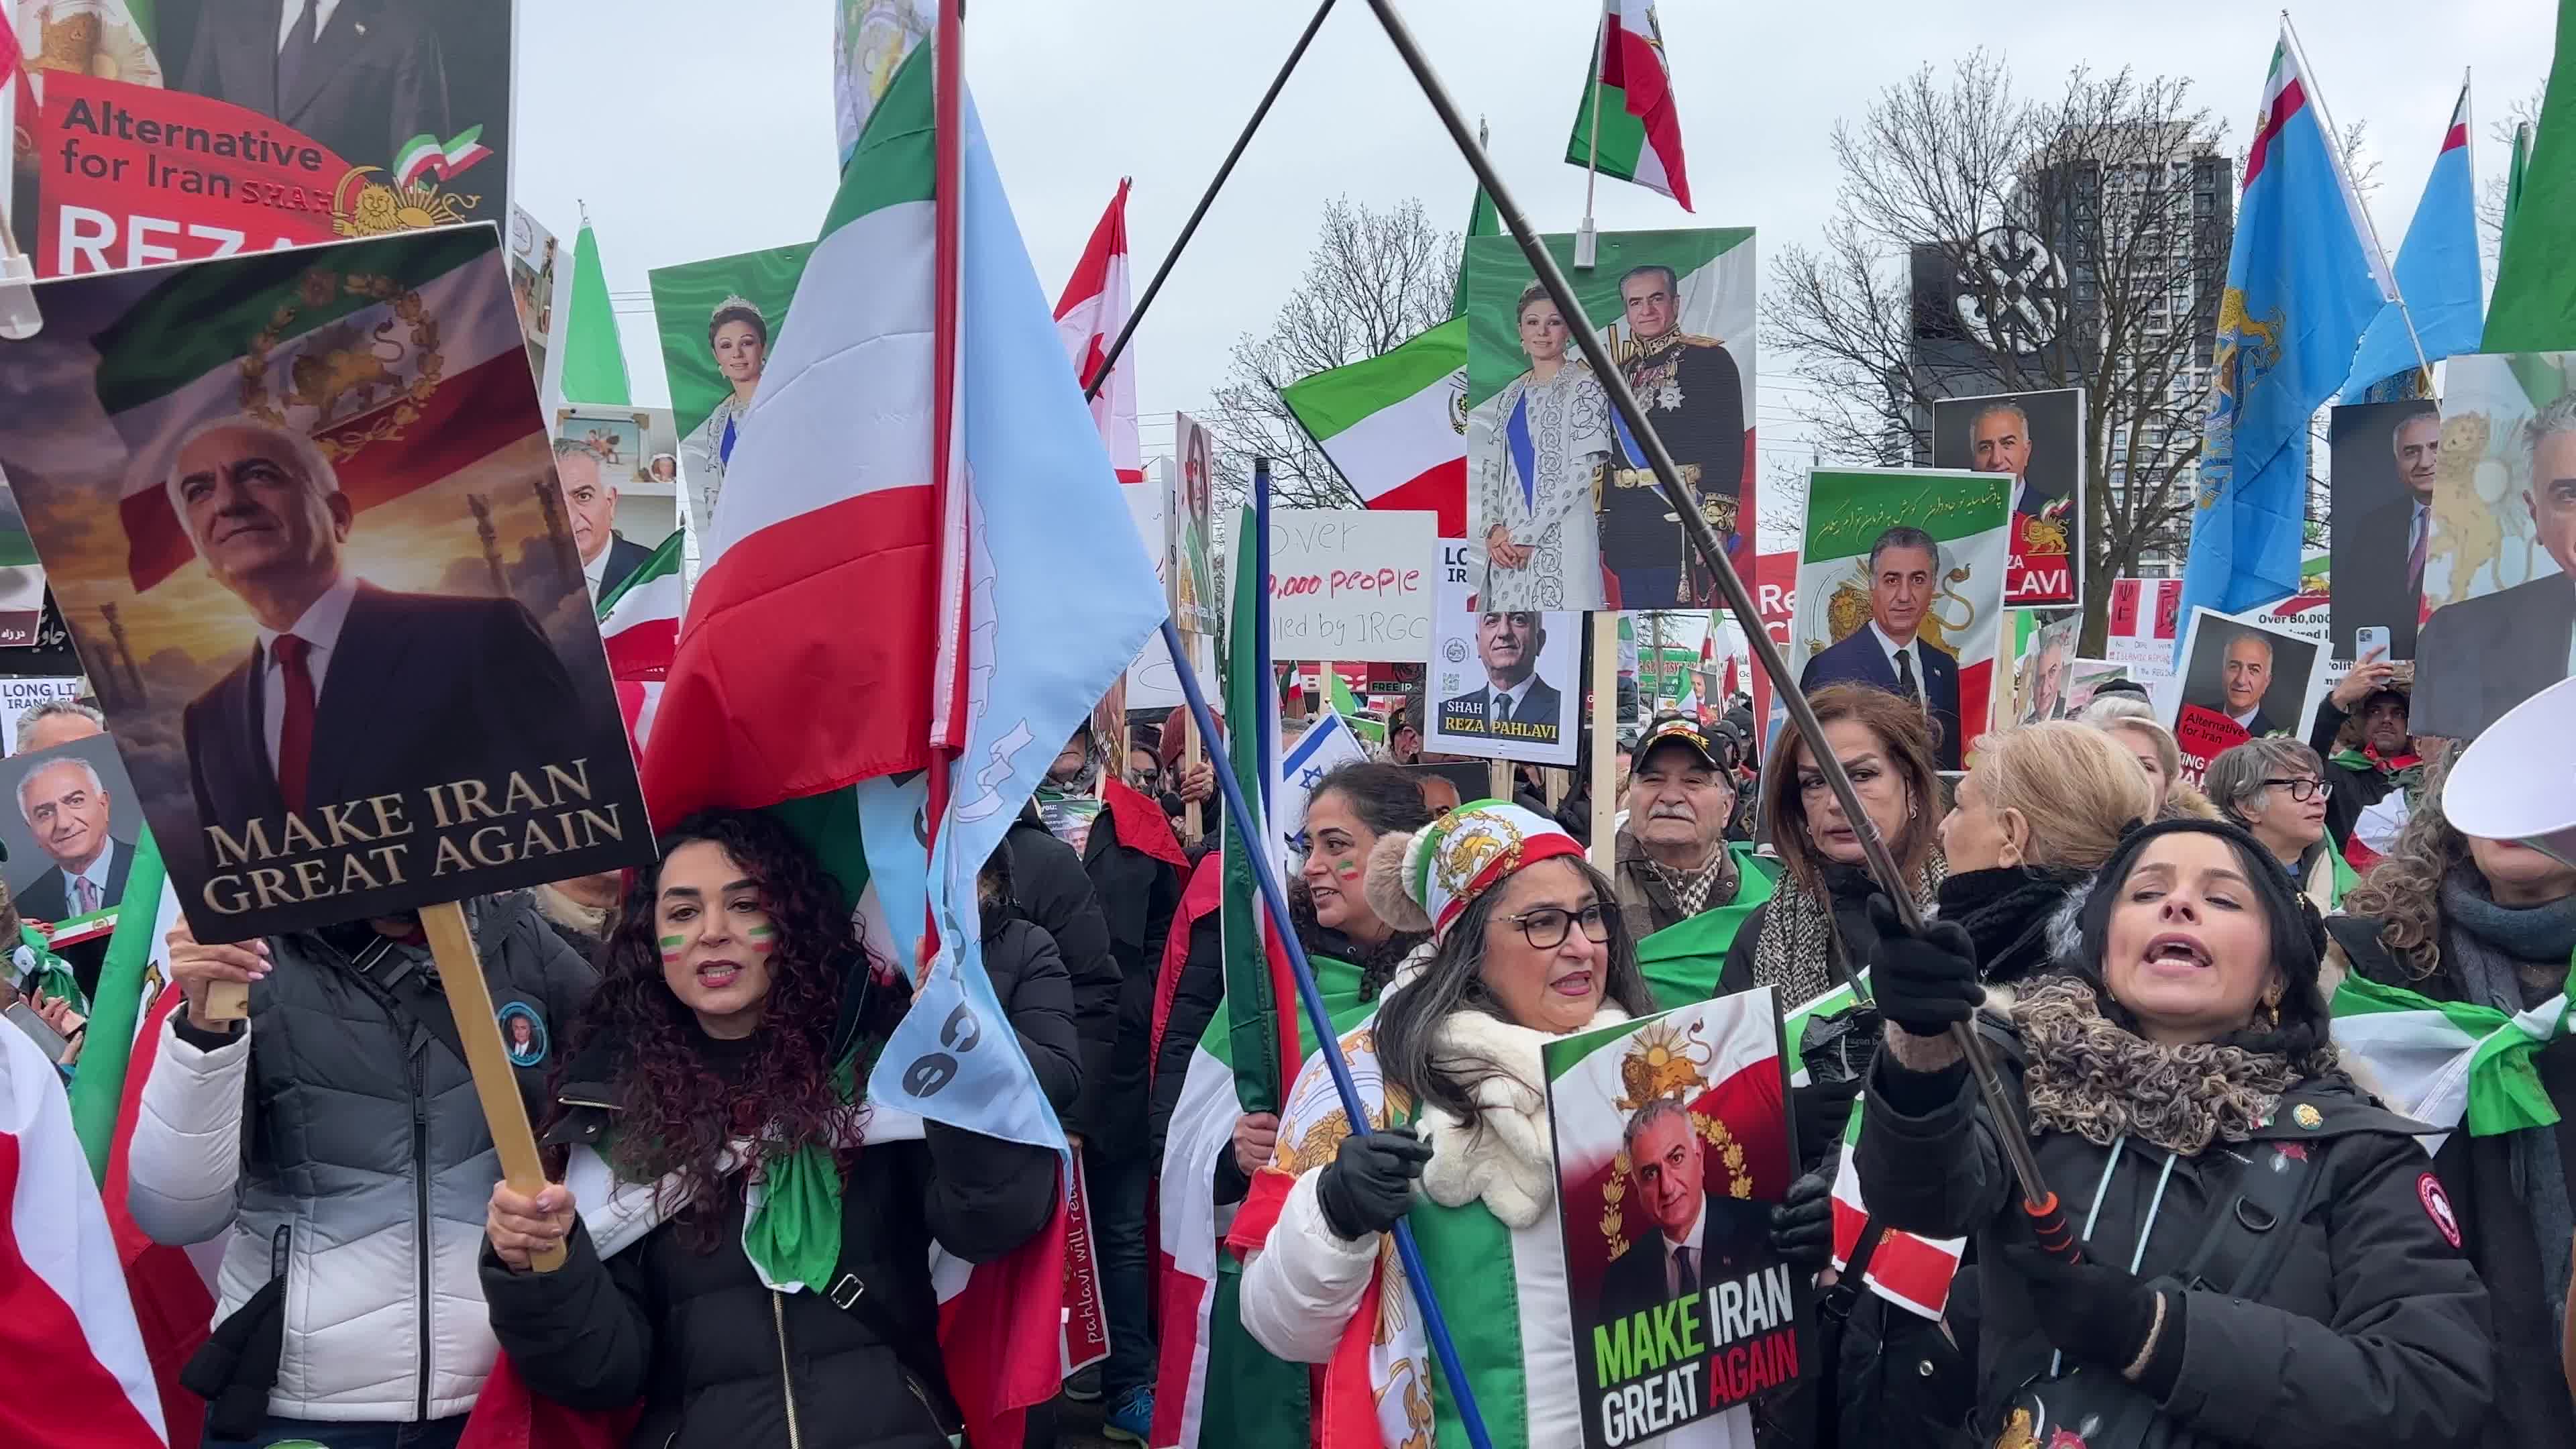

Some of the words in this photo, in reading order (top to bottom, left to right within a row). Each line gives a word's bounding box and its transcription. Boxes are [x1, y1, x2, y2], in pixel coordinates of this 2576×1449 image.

[61, 98, 323, 172] Alternative
[60, 140, 129, 181] for
[148, 154, 231, 199] Iran
[59, 204, 297, 276] REZ
[1331, 568, 1419, 599] people
[1319, 613, 1346, 646] by
[1358, 612, 1428, 644] IRGC
[3, 683, 51, 697] LONG
[1372, 683, 1399, 692] FREE
[1447, 701, 1483, 714] SHAH
[2186, 712, 2246, 737] Alternative
[1445, 716, 1486, 733] REZA
[1491, 719, 1557, 740] PAHLAVI
[2183, 724, 2199, 736] for
[2201, 730, 2222, 745] Iran
[204, 792, 413, 867] MAKE
[424, 758, 593, 828] IRAN
[203, 844, 408, 914] GREAT
[431, 803, 623, 876] AGAIN
[1068, 1226, 1088, 1263] will
[1073, 1267, 1104, 1344] pahlavi
[1593, 1293, 1705, 1389] MAKE
[1707, 1263, 1794, 1348] IRAN
[1601, 1362, 1701, 1449] GREAT
[1708, 1327, 1799, 1408] AGAIN
